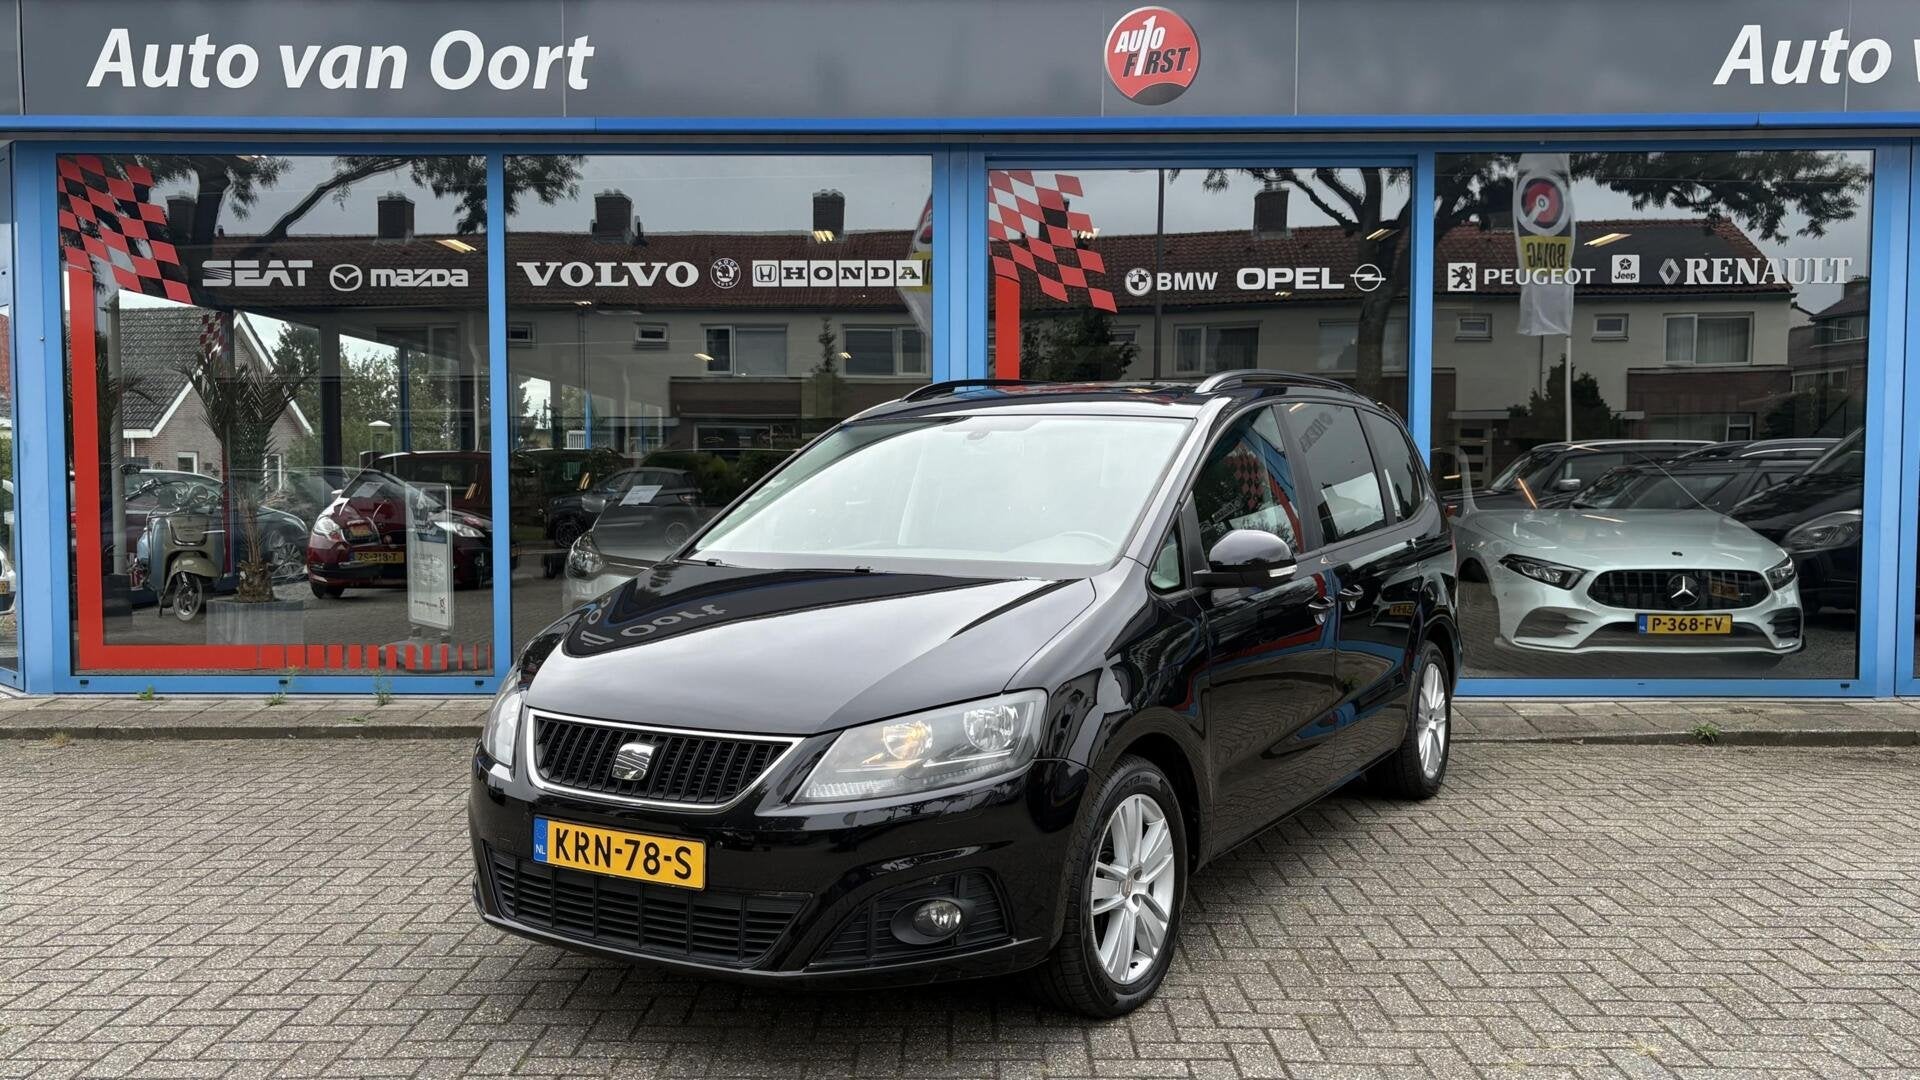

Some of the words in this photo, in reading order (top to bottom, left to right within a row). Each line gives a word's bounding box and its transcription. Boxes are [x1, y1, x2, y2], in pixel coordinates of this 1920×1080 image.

[87, 28, 260, 89] Auto
[280, 44, 407, 90] van
[430, 29, 595, 91] Oort
[1713, 24, 1892, 85] Auto
[201, 259, 313, 287] SEAT
[370, 267, 468, 287] mazda
[516, 261, 700, 288] VOLVO
[781, 264, 922, 283] HONDA
[1157, 271, 1219, 291] BMW
[1236, 266, 1345, 290] OPEL
[1483, 267, 1596, 286] PEUGEOT
[1614, 270, 1636, 281] Jeep
[1684, 257, 1853, 285] RENAULT
[1651, 617, 1724, 632] P-368-FV
[535, 843, 547, 856] NL
[555, 827, 692, 881] KRN-78-S
